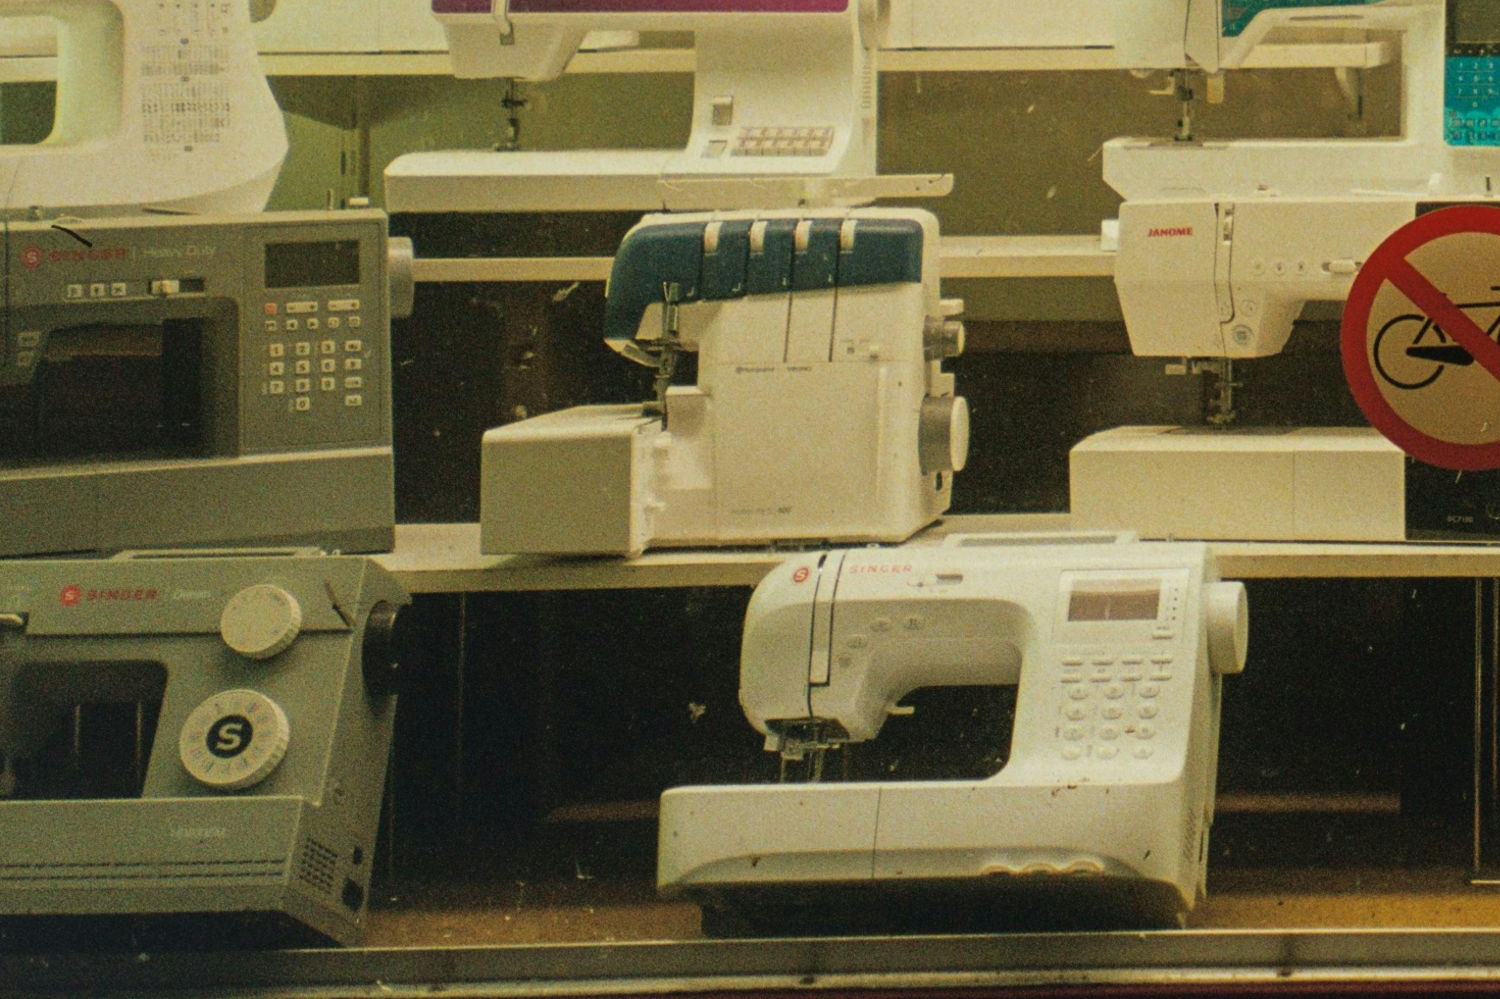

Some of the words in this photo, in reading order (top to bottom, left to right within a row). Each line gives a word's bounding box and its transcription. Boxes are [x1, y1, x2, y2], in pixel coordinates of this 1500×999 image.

[1147, 227, 1194, 238] JANOME
[849, 564, 913, 574] SINGER
[87, 588, 159, 601] SINGER
[215, 722, 244, 751] S
